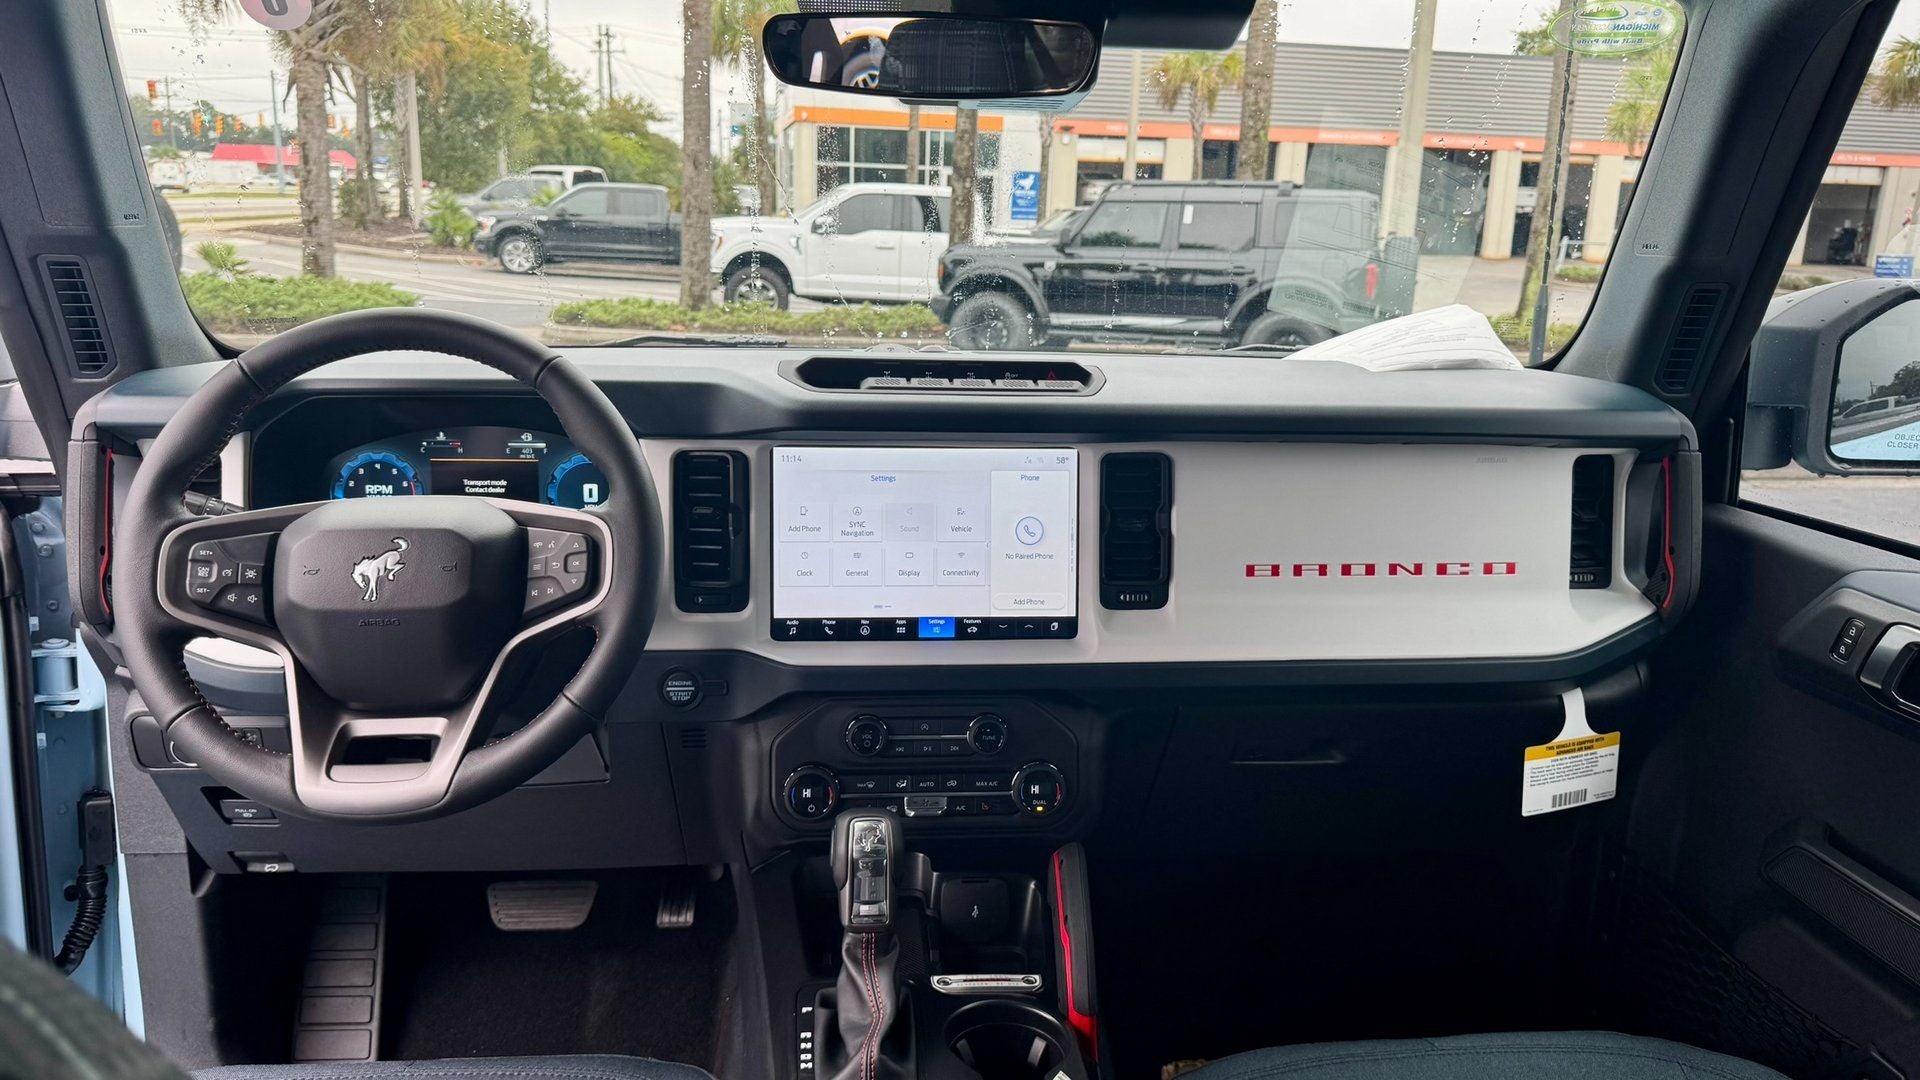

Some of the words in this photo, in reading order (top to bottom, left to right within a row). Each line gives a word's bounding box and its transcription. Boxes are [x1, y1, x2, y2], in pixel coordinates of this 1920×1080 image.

[365, 485, 393, 494] RPM
[583, 484, 598, 503] 0
[1246, 562, 1516, 577] BRONCO
[802, 789, 811, 798] HI
[1031, 785, 1040, 794] HI
